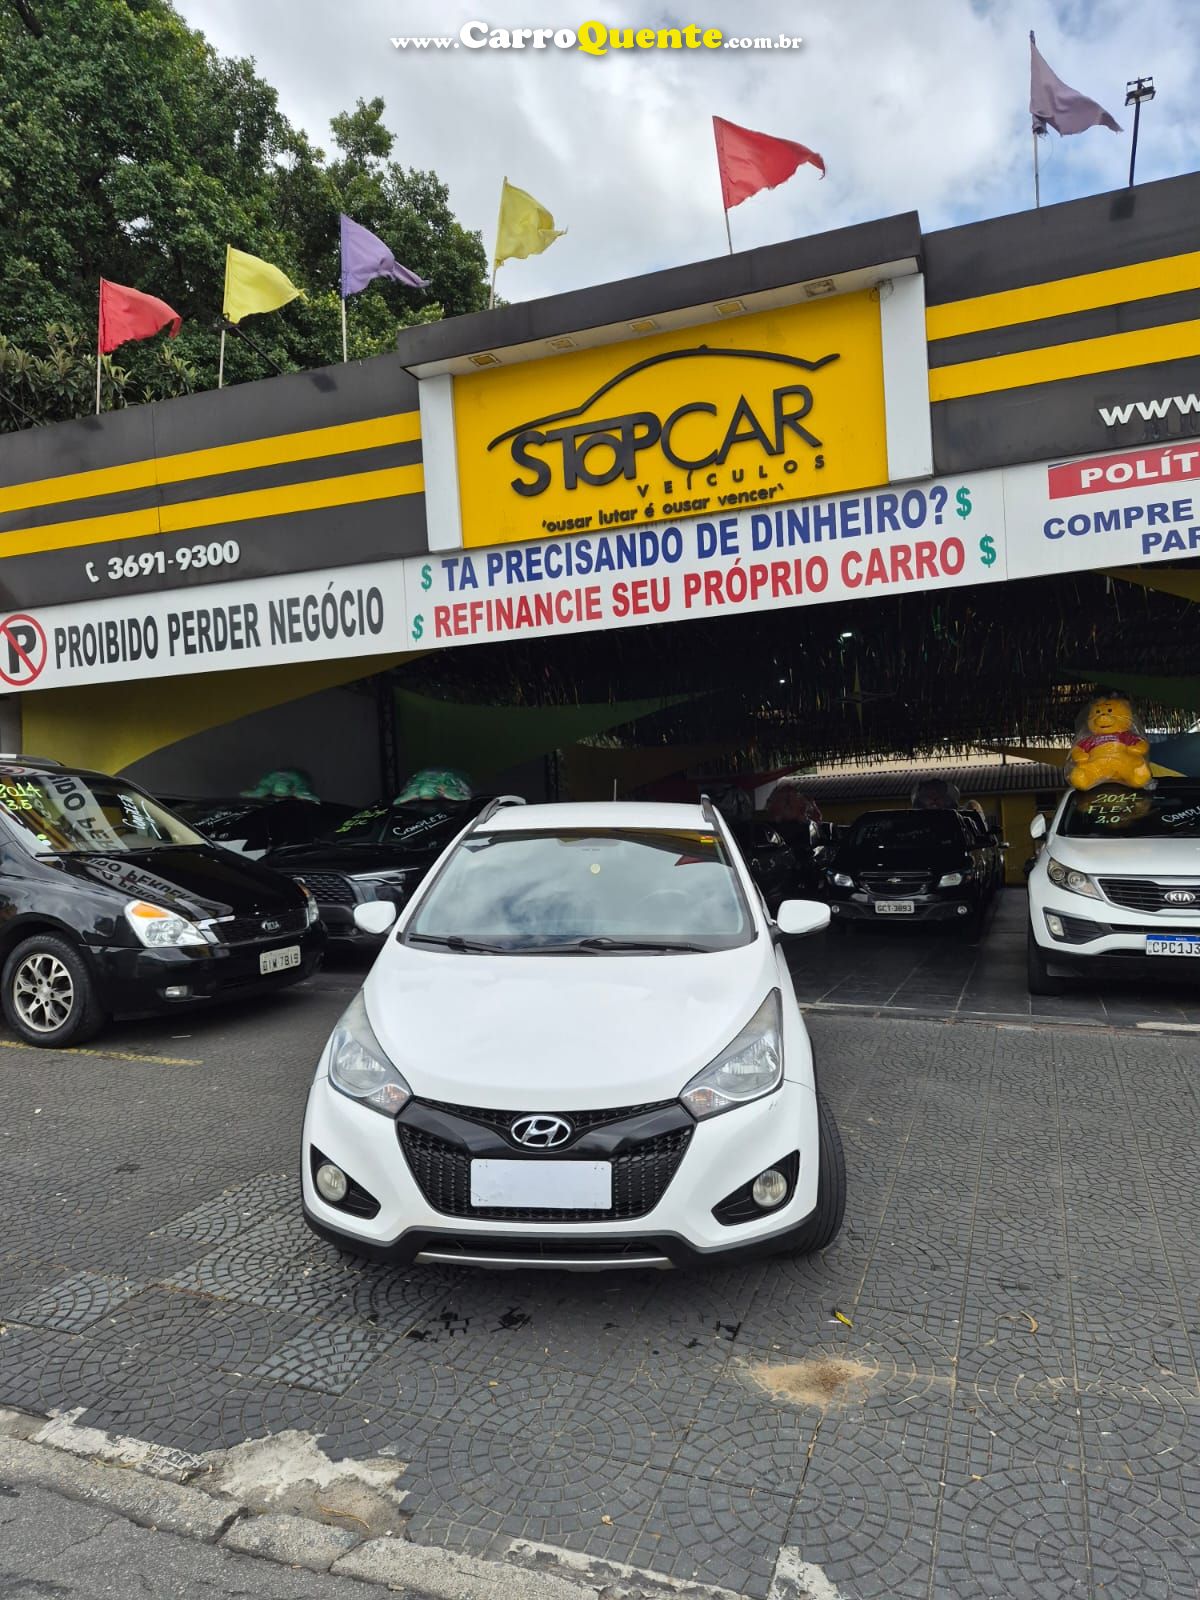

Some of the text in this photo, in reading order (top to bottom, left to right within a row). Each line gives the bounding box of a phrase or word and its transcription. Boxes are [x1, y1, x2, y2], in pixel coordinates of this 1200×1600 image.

[636, 454, 825, 498] VEÍCULOS
[598, 506, 639, 525] lutar
[643, 502, 655, 518] é
[662, 497, 711, 516] ousar
[1043, 498, 1195, 540] COMPRE
[106, 539, 242, 581] 3691-9300
[441, 556, 479, 592] TA
[487, 525, 685, 587] PRECISANDO
[696, 515, 741, 560] DE
[751, 484, 949, 552] DINHEIRO?
[434, 585, 603, 640] REFINANCIE
[611, 575, 672, 619] SEU
[683, 556, 830, 610] PRÓPRIO
[841, 536, 967, 592] CARRO
[54, 581, 385, 670] PROIBIDO PERDER NEGÓCIO
